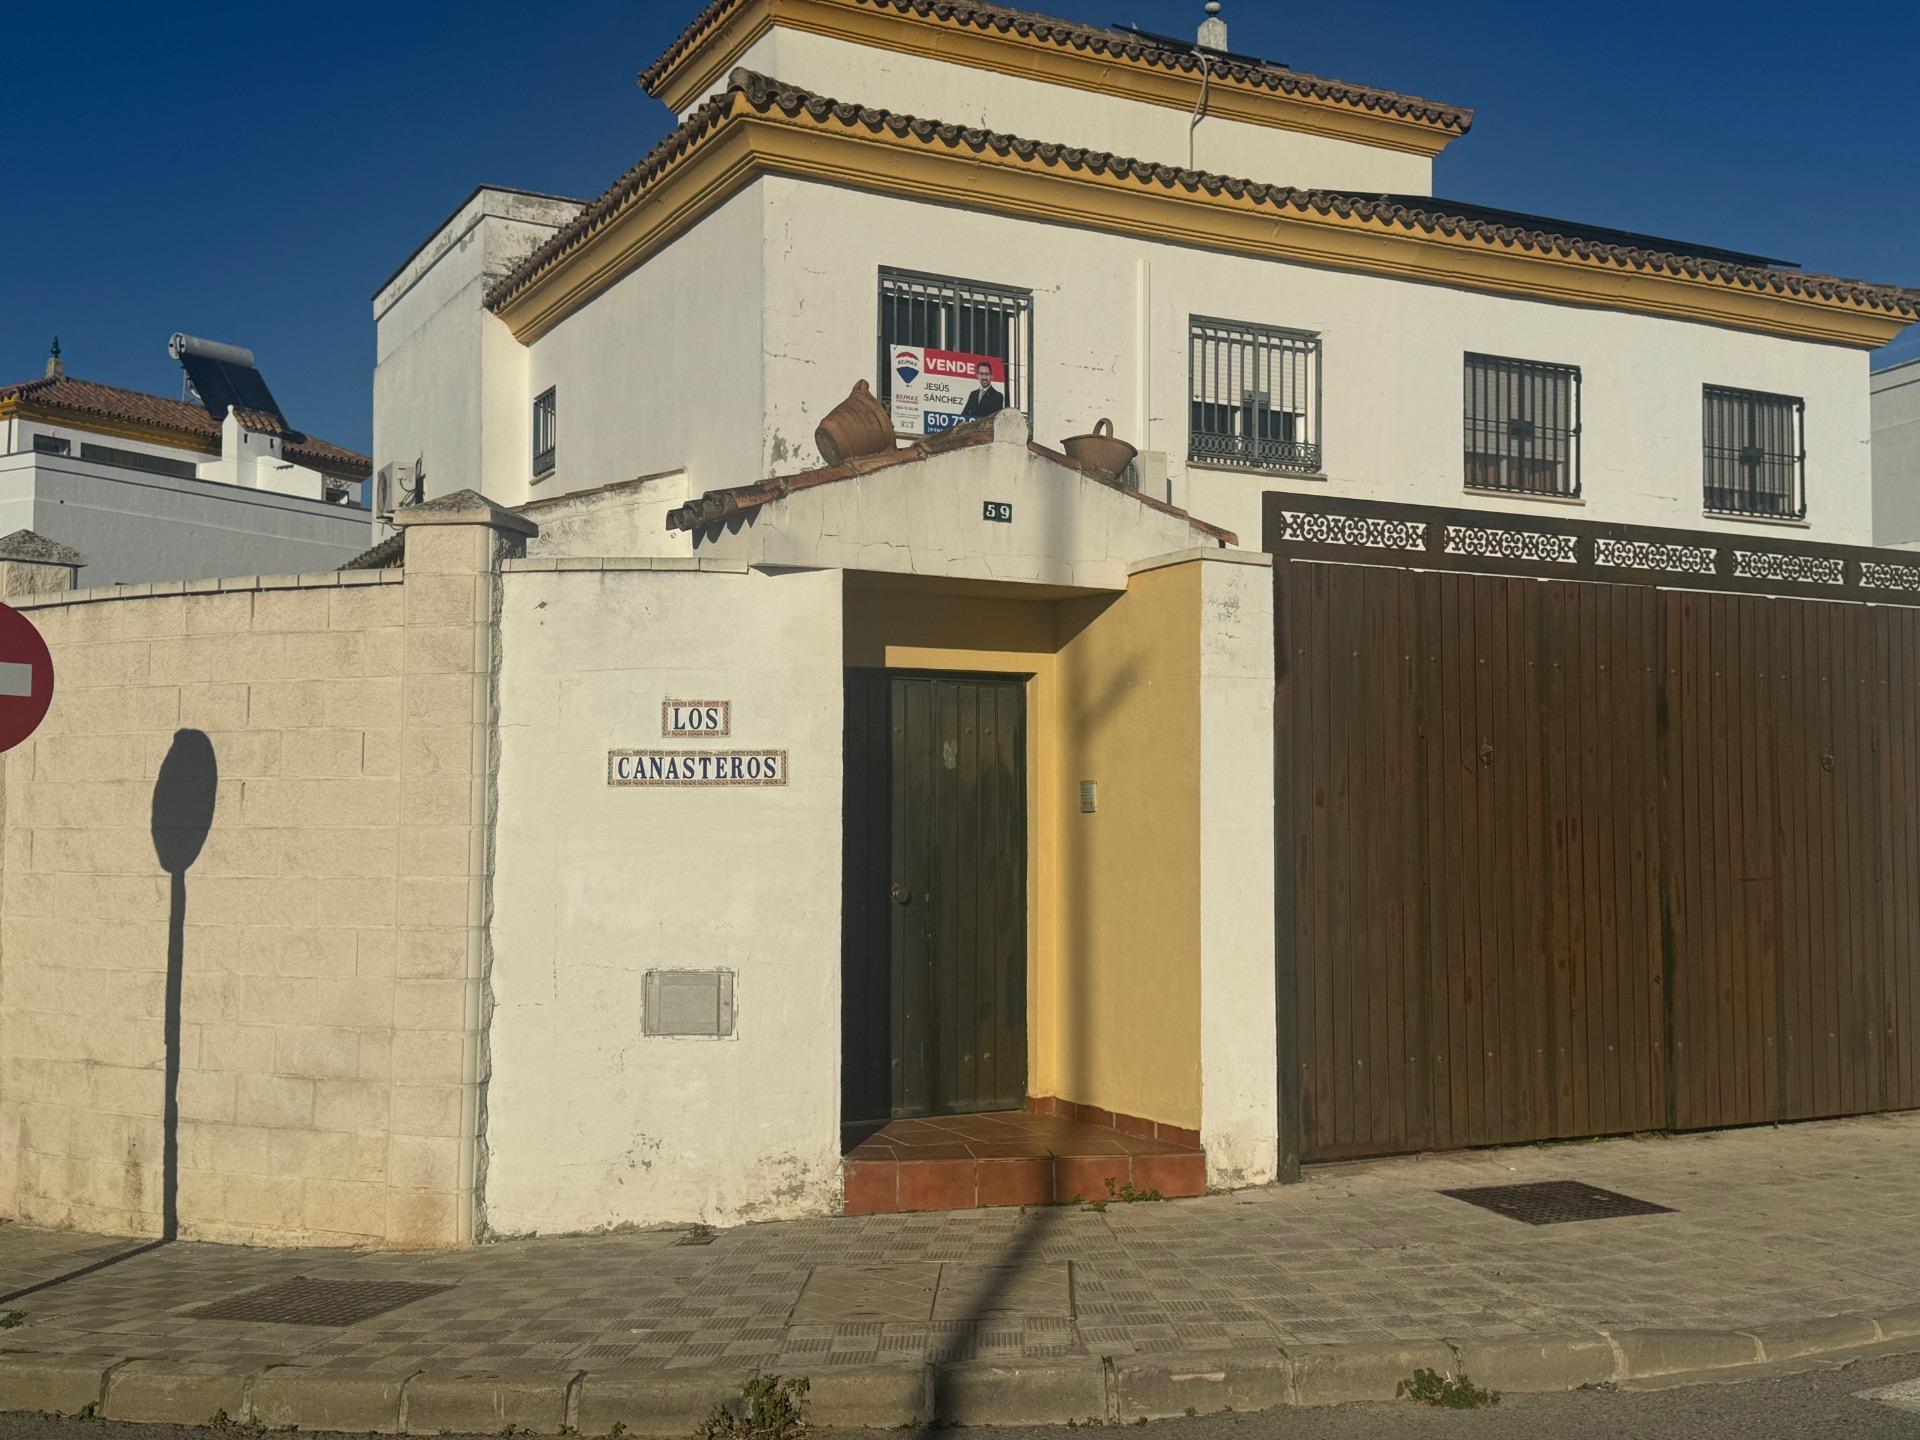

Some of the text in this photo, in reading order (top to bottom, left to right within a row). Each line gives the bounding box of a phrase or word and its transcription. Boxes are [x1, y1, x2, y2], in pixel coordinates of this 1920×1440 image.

[926, 357, 975, 375] VENDE
[924, 382, 950, 392] JESÚS
[924, 393, 964, 405] SÁNCHEZ
[927, 413, 948, 426] 610
[986, 504, 1010, 519] 59
[673, 708, 718, 730] LOS
[618, 757, 776, 779] CANASTEROS
